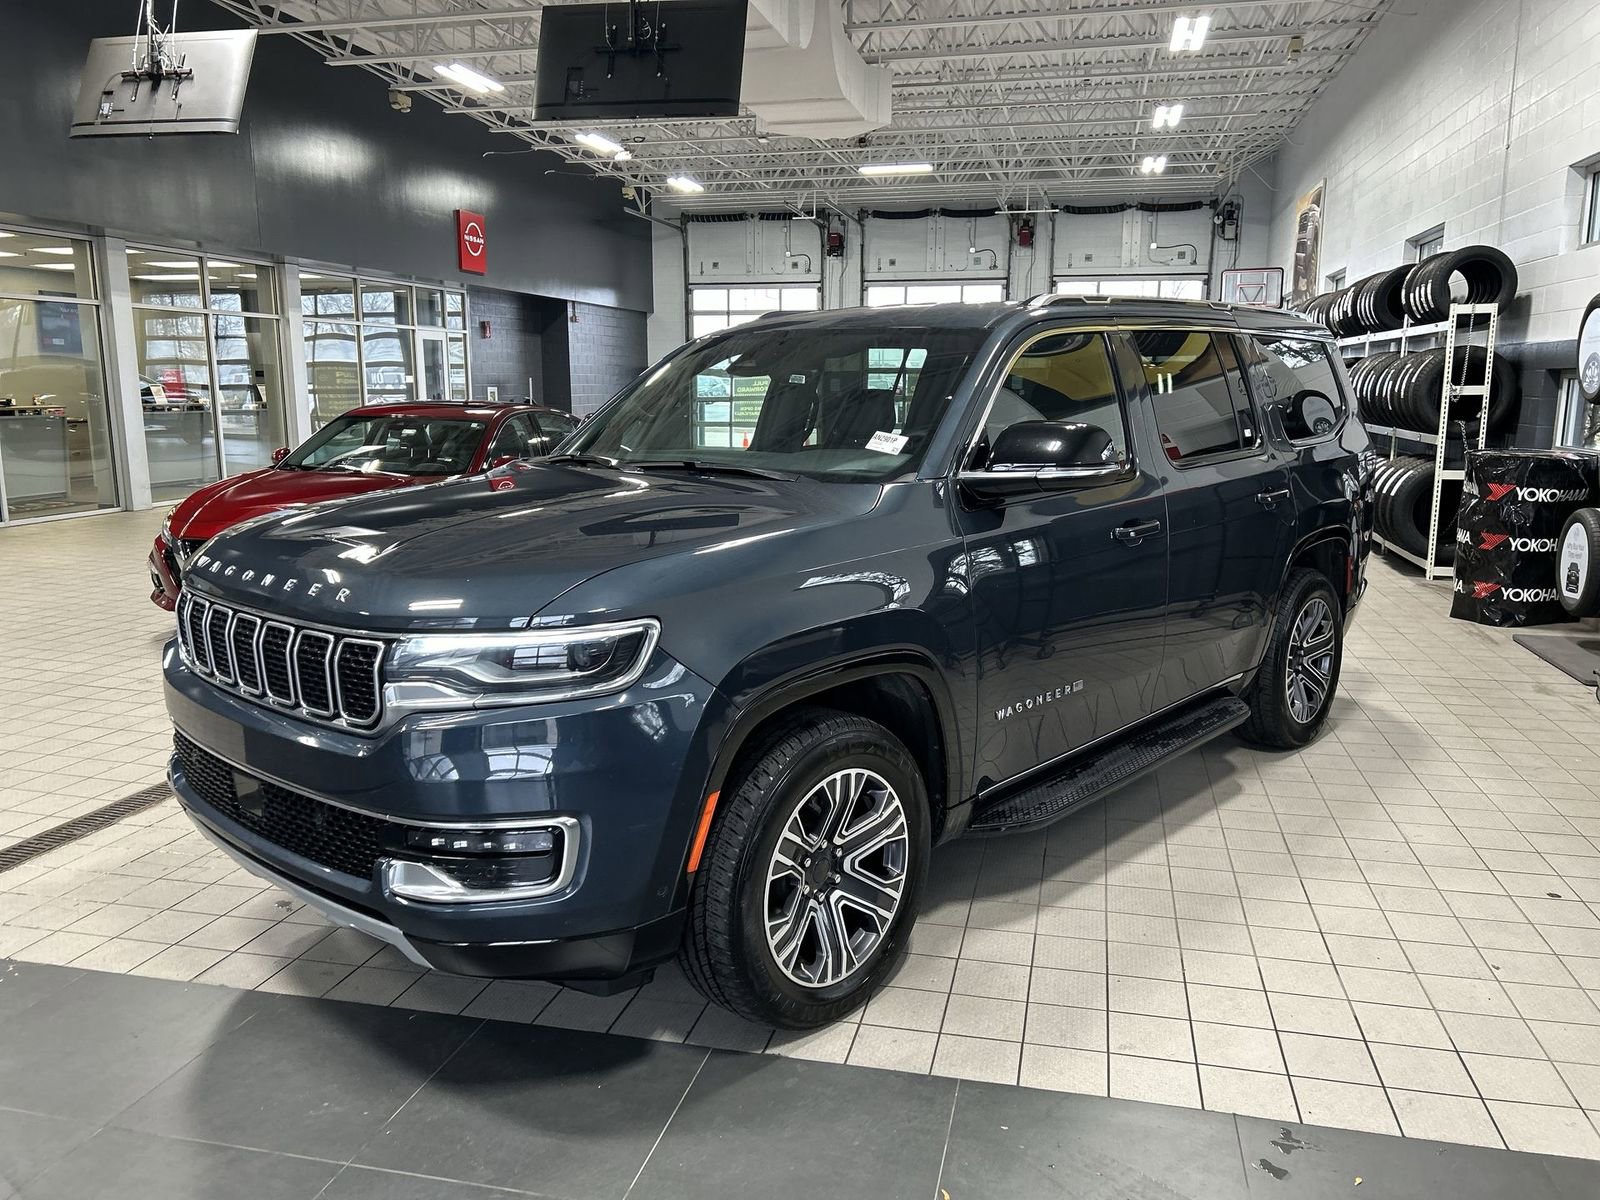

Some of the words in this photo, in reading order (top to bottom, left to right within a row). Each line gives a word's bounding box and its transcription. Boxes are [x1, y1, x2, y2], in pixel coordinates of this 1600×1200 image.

[464, 234, 484, 245] NISSAN
[1508, 537, 1558, 553] YOKOH
[196, 555, 351, 603] WAGONEER
[1501, 586, 1560, 603] YOKOHA
[995, 685, 1071, 721] WAGONEER
